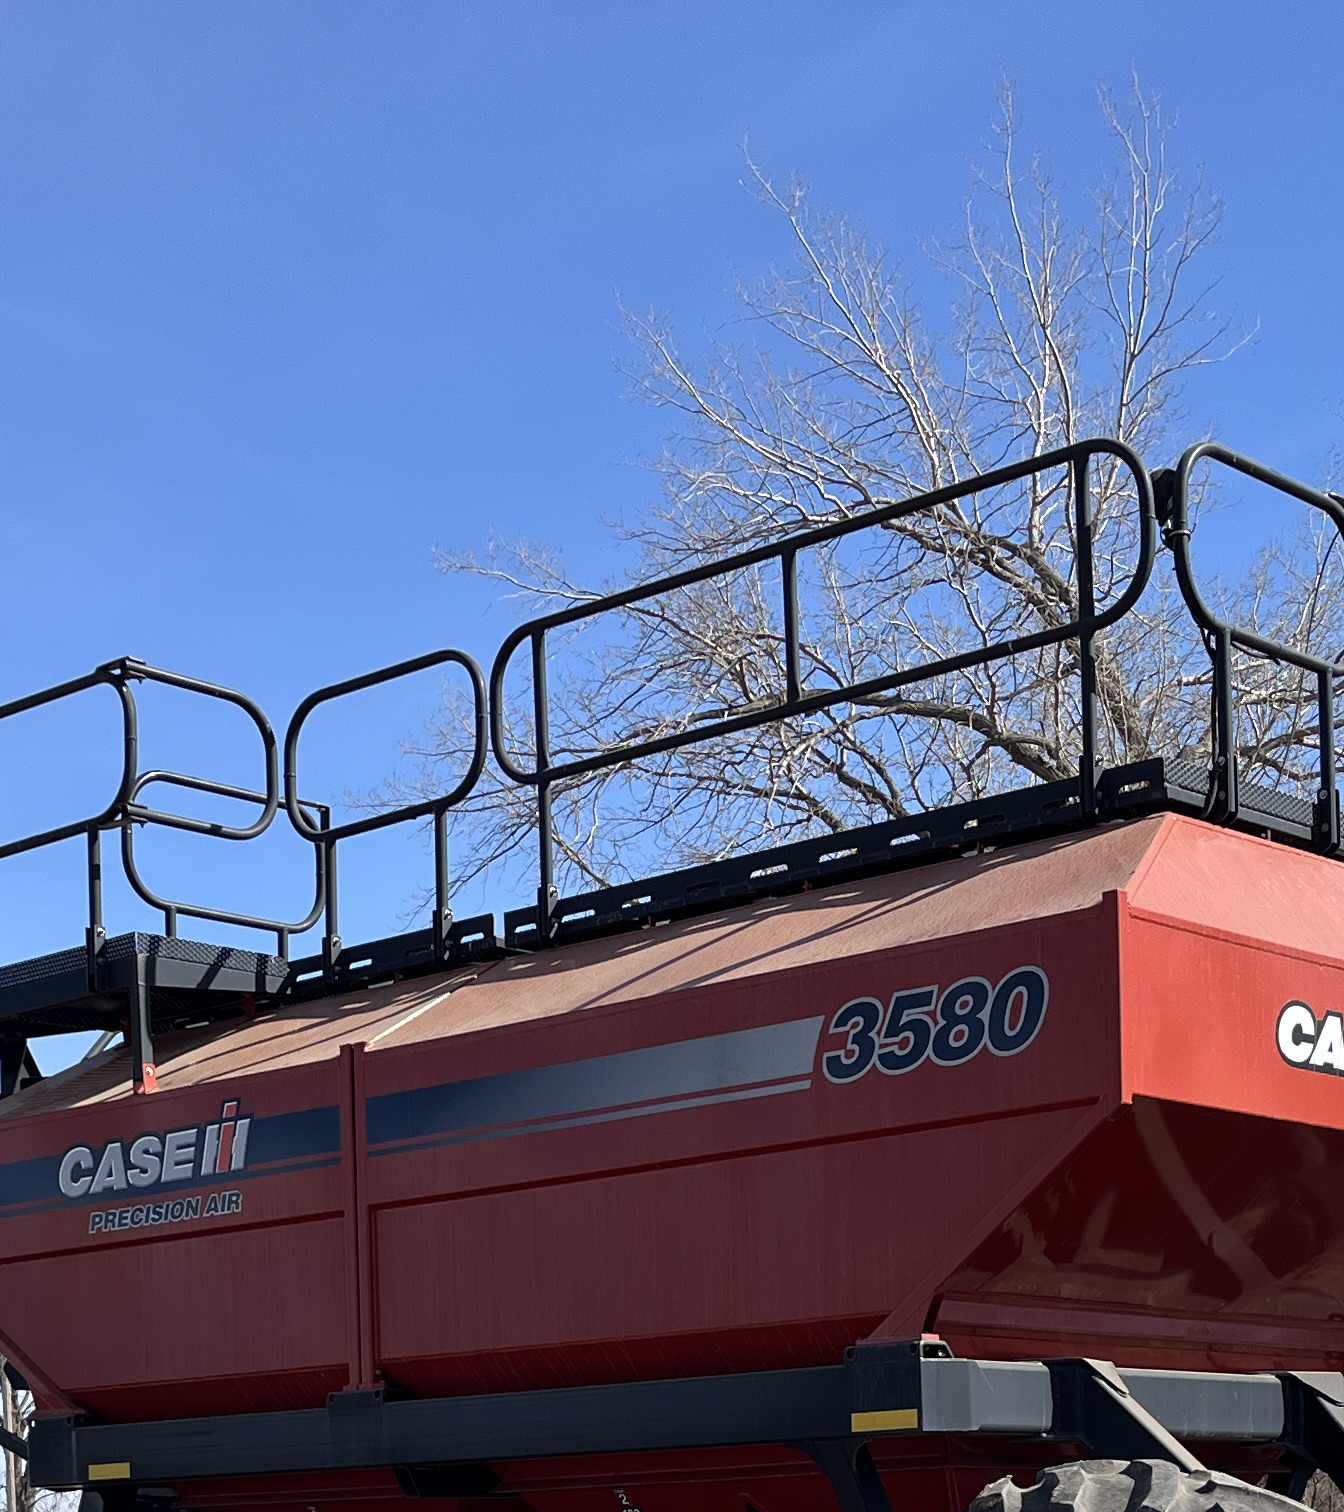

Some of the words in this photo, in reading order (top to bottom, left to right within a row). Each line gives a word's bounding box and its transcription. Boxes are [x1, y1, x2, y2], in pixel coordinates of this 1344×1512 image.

[822, 965, 1049, 1084] 3580
[58, 1128, 199, 1198] CASE
[88, 1196, 202, 1234] PRECISION
[202, 1190, 243, 1217] AIR
[618, 1493, 630, 1505] 2
